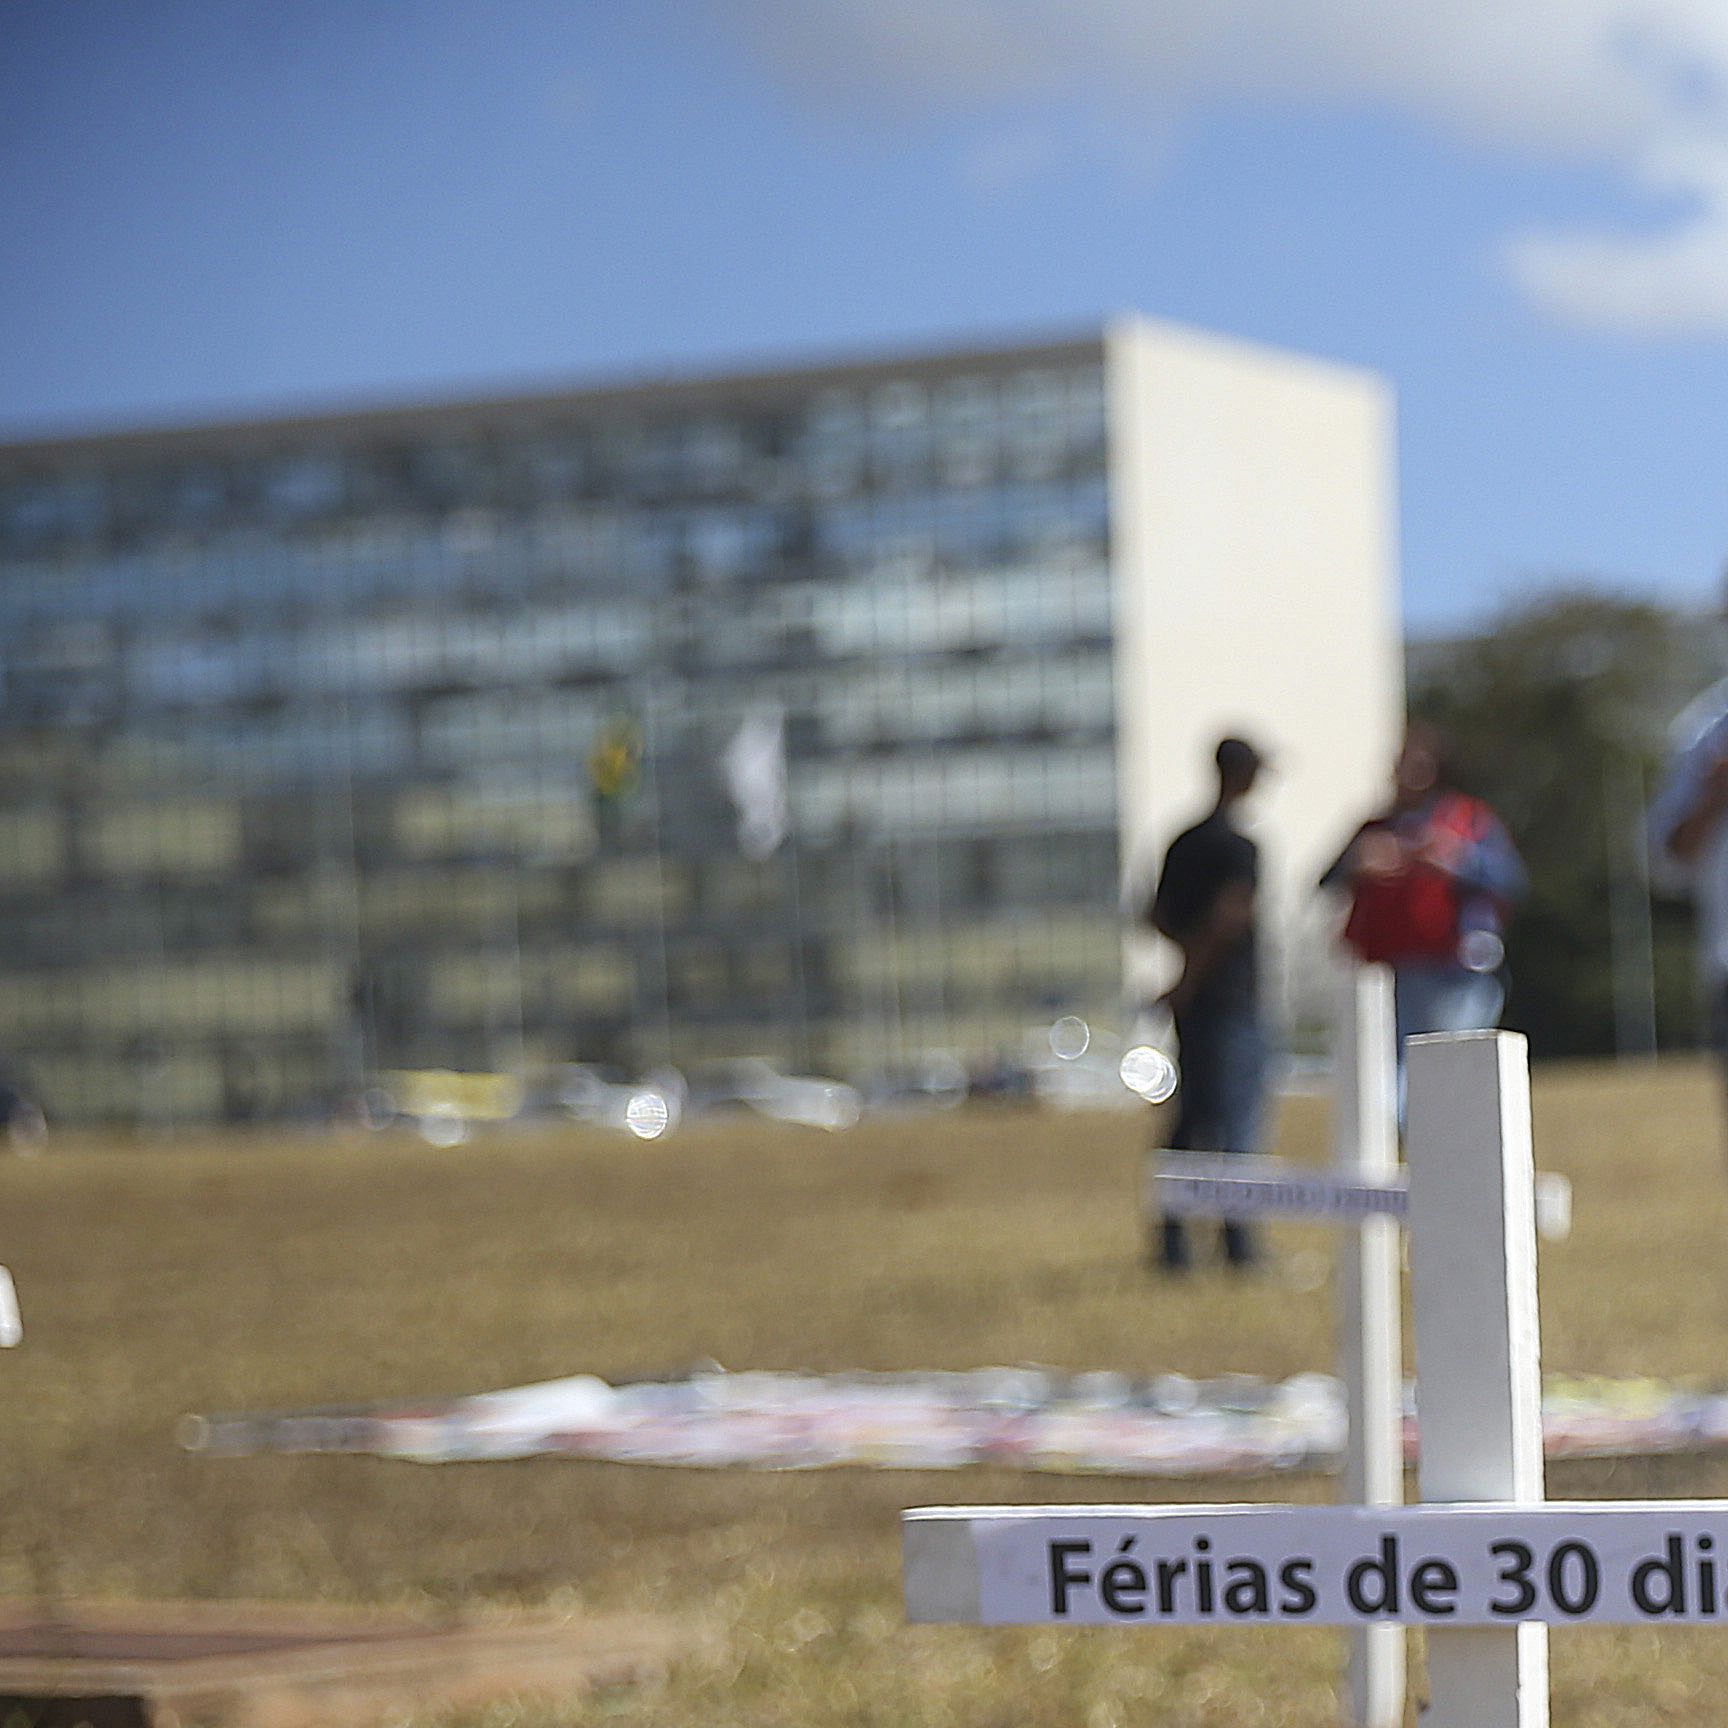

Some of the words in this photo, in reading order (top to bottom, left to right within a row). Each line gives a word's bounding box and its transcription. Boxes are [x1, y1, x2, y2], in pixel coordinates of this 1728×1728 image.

[1046, 1535, 1318, 1615] Férias
[1346, 1533, 1460, 1615] de
[1488, 1539, 1600, 1615] 30
